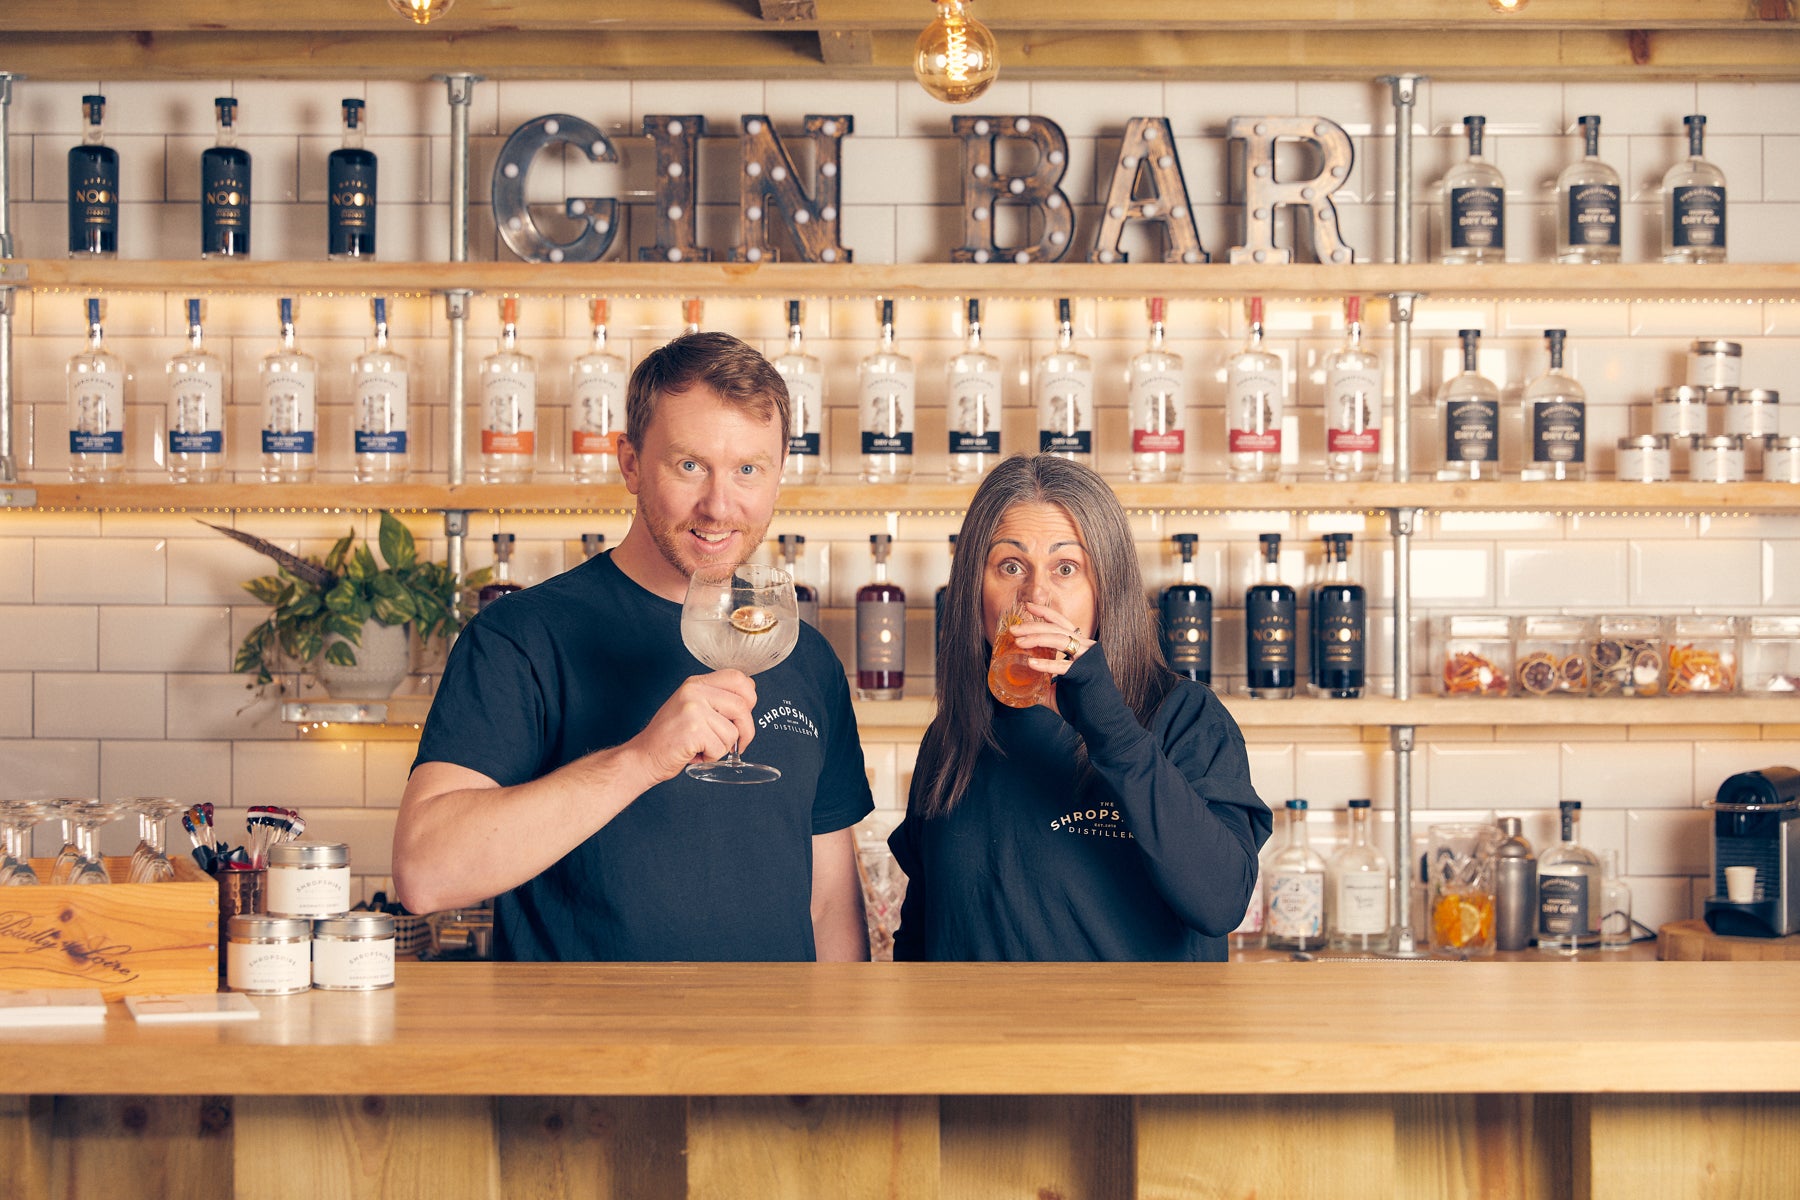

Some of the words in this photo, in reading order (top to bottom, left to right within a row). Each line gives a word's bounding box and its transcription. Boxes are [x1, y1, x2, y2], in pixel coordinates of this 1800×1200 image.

[492, 114, 853, 263] GIN
[951, 114, 1355, 264] BAR
[758, 706, 819, 739] SHROPSHIRE
[773, 723, 813, 737] DISTILLERY
[1050, 809, 1124, 831] SHROPS
